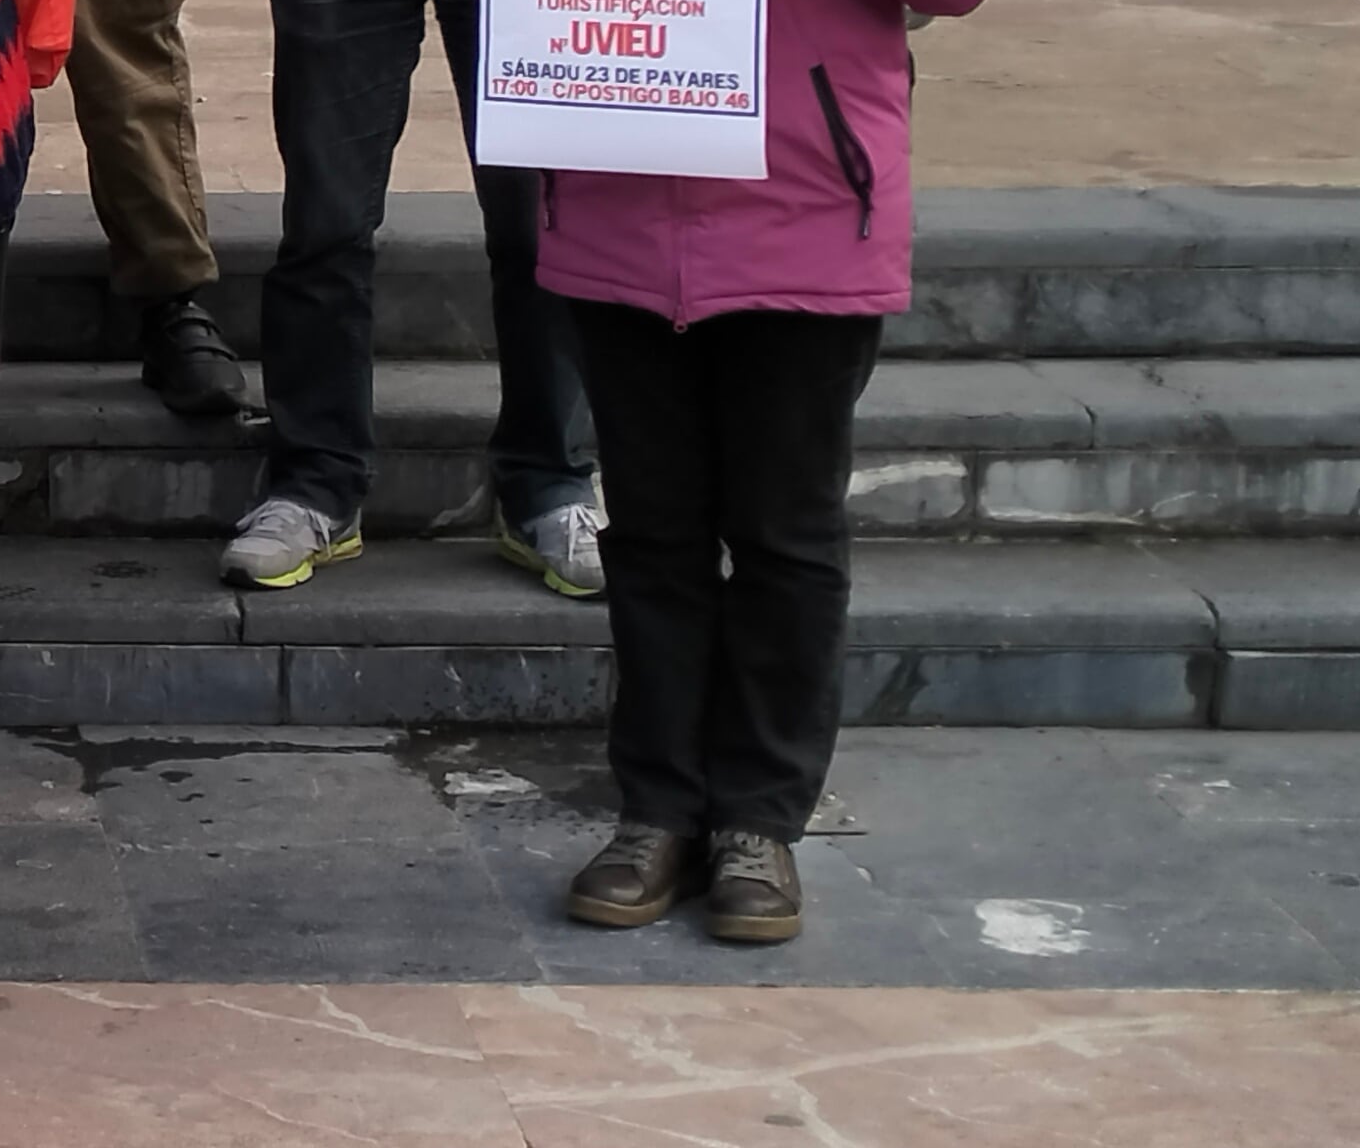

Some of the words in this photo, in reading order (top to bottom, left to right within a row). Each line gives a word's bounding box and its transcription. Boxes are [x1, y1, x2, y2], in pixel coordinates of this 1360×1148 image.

[492, 78, 537, 96] 17:00
[551, 82, 662, 104] C/POSTIGO
[668, 88, 718, 107] BAJO
[725, 92, 749, 109] 46
